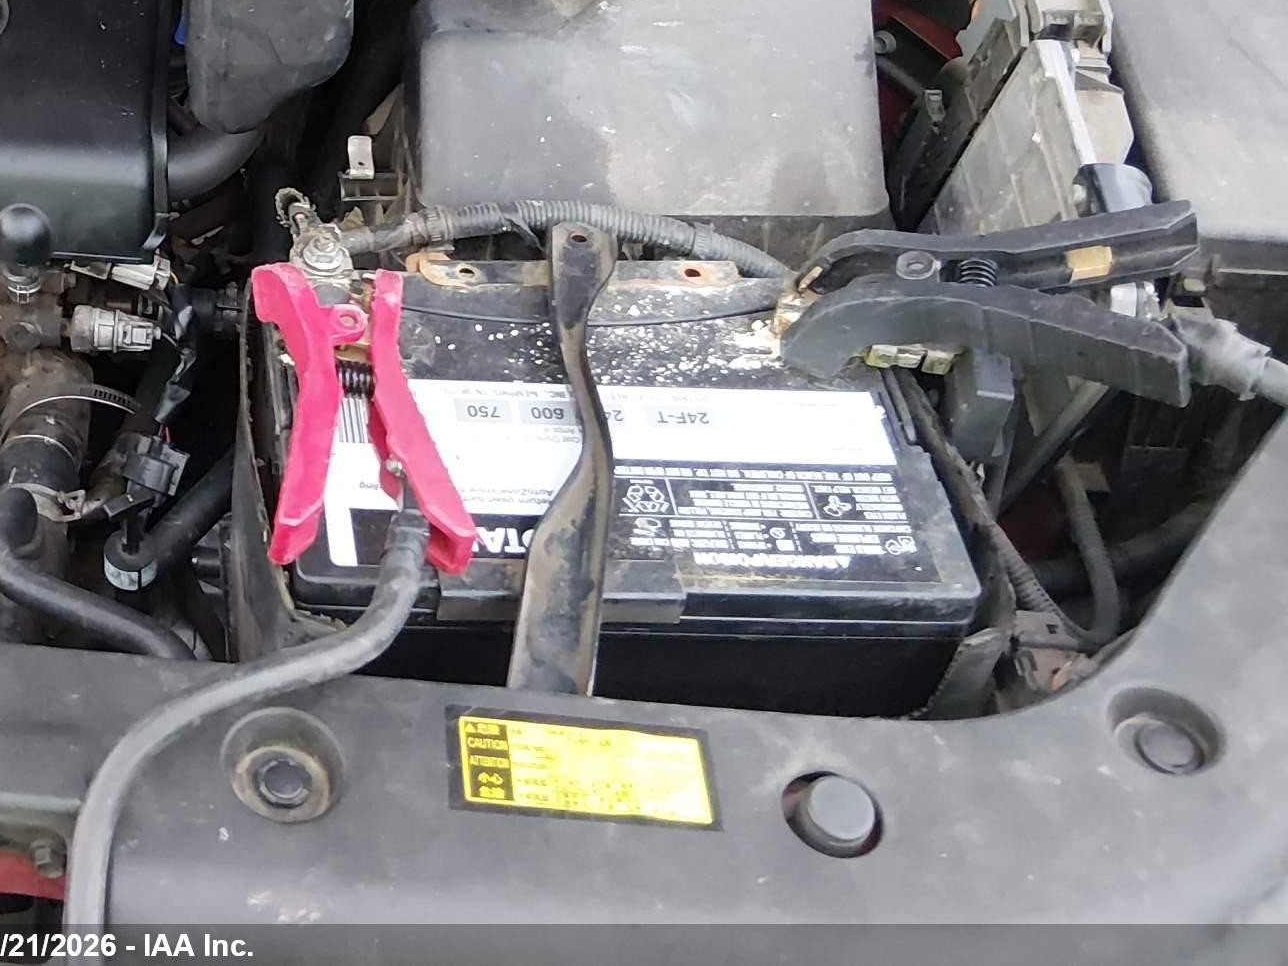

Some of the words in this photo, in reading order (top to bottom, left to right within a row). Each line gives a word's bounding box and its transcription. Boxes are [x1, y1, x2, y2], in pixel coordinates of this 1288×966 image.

[467, 405, 502, 418] 750
[531, 406, 565, 420] 600
[658, 411, 710, 425] 24F-T
[467, 736, 509, 751] CAUTION
